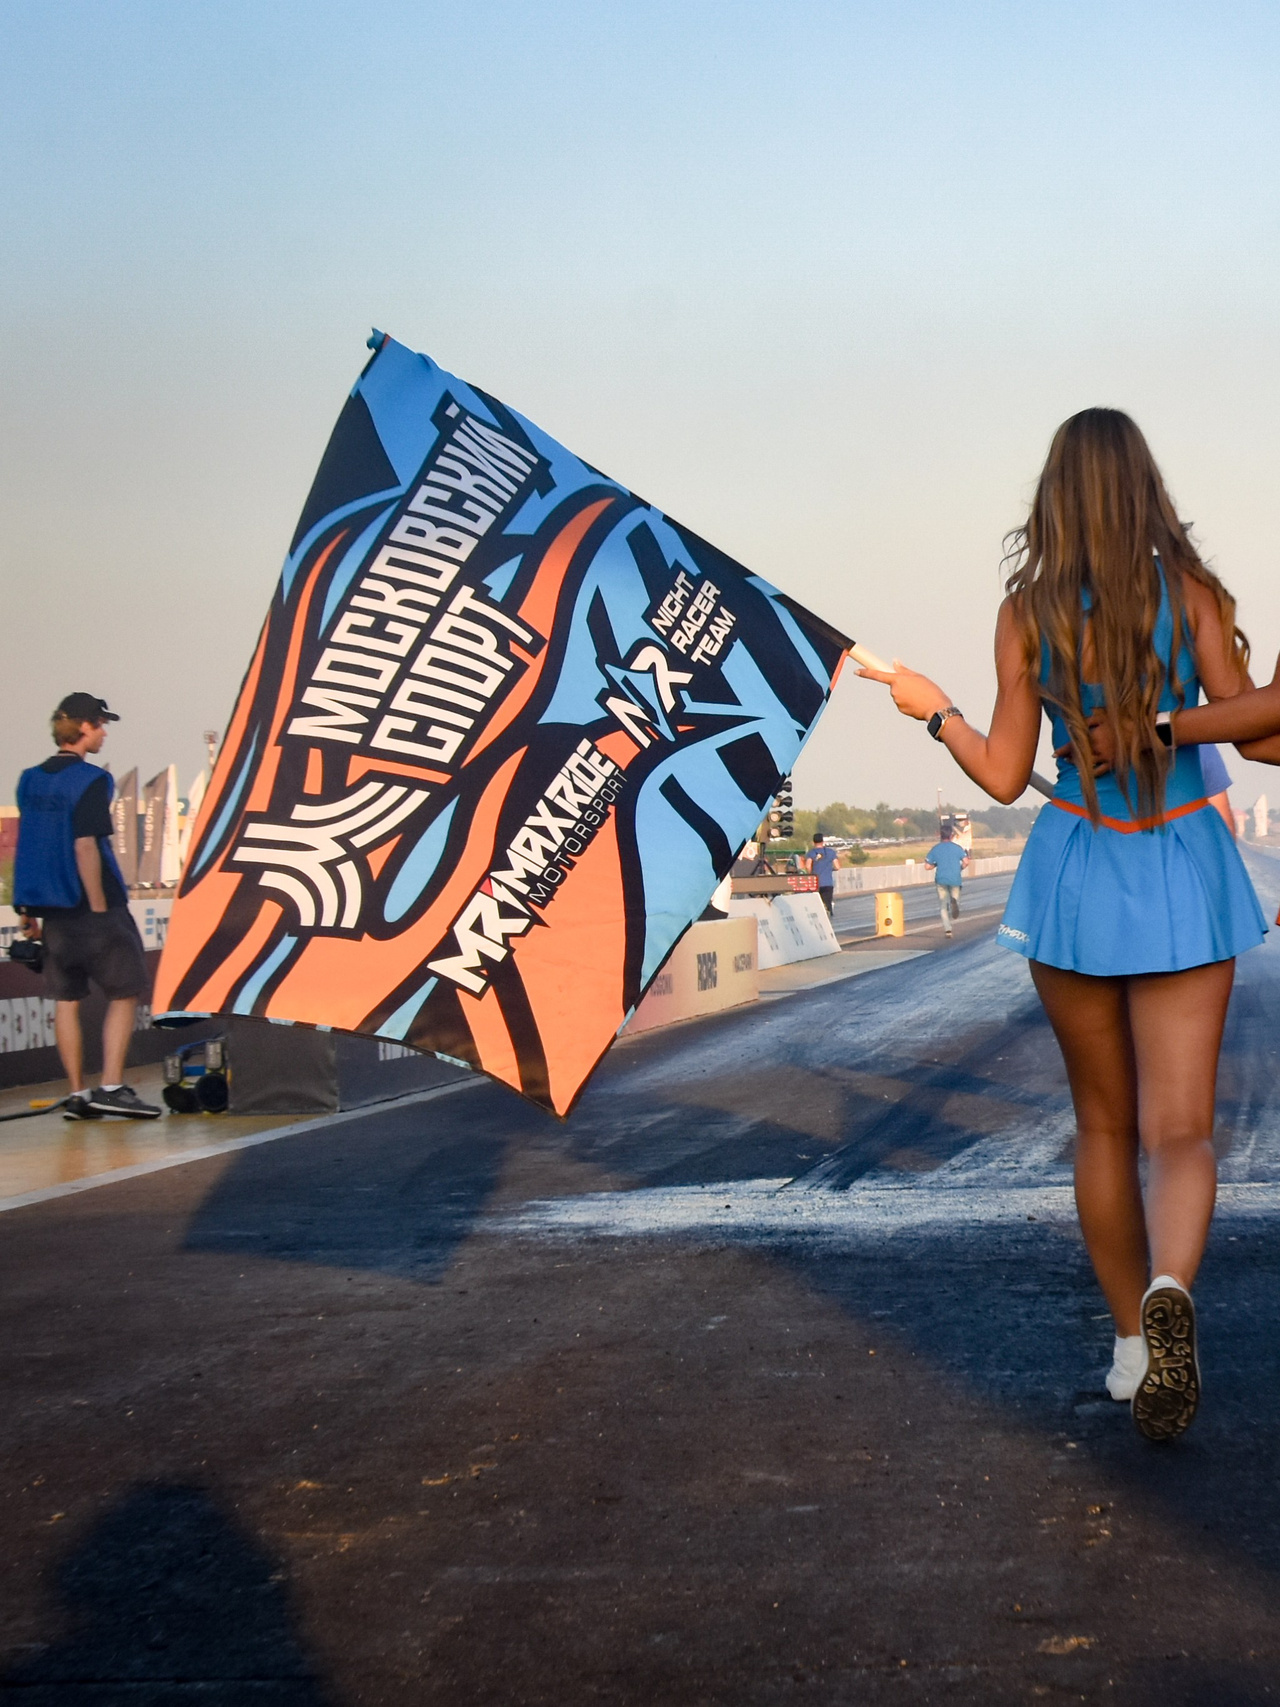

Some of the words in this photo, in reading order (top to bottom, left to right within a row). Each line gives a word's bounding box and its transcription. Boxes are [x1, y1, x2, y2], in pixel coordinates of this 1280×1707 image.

[287, 404, 539, 744] МОСКОВСКИЙ
[652, 571, 695, 635] NIGHT
[670, 580, 721, 654] RACER
[370, 585, 533, 764] СПОРТ
[691, 607, 737, 666] TEAM
[529, 770, 629, 904] MOTORSPORT
